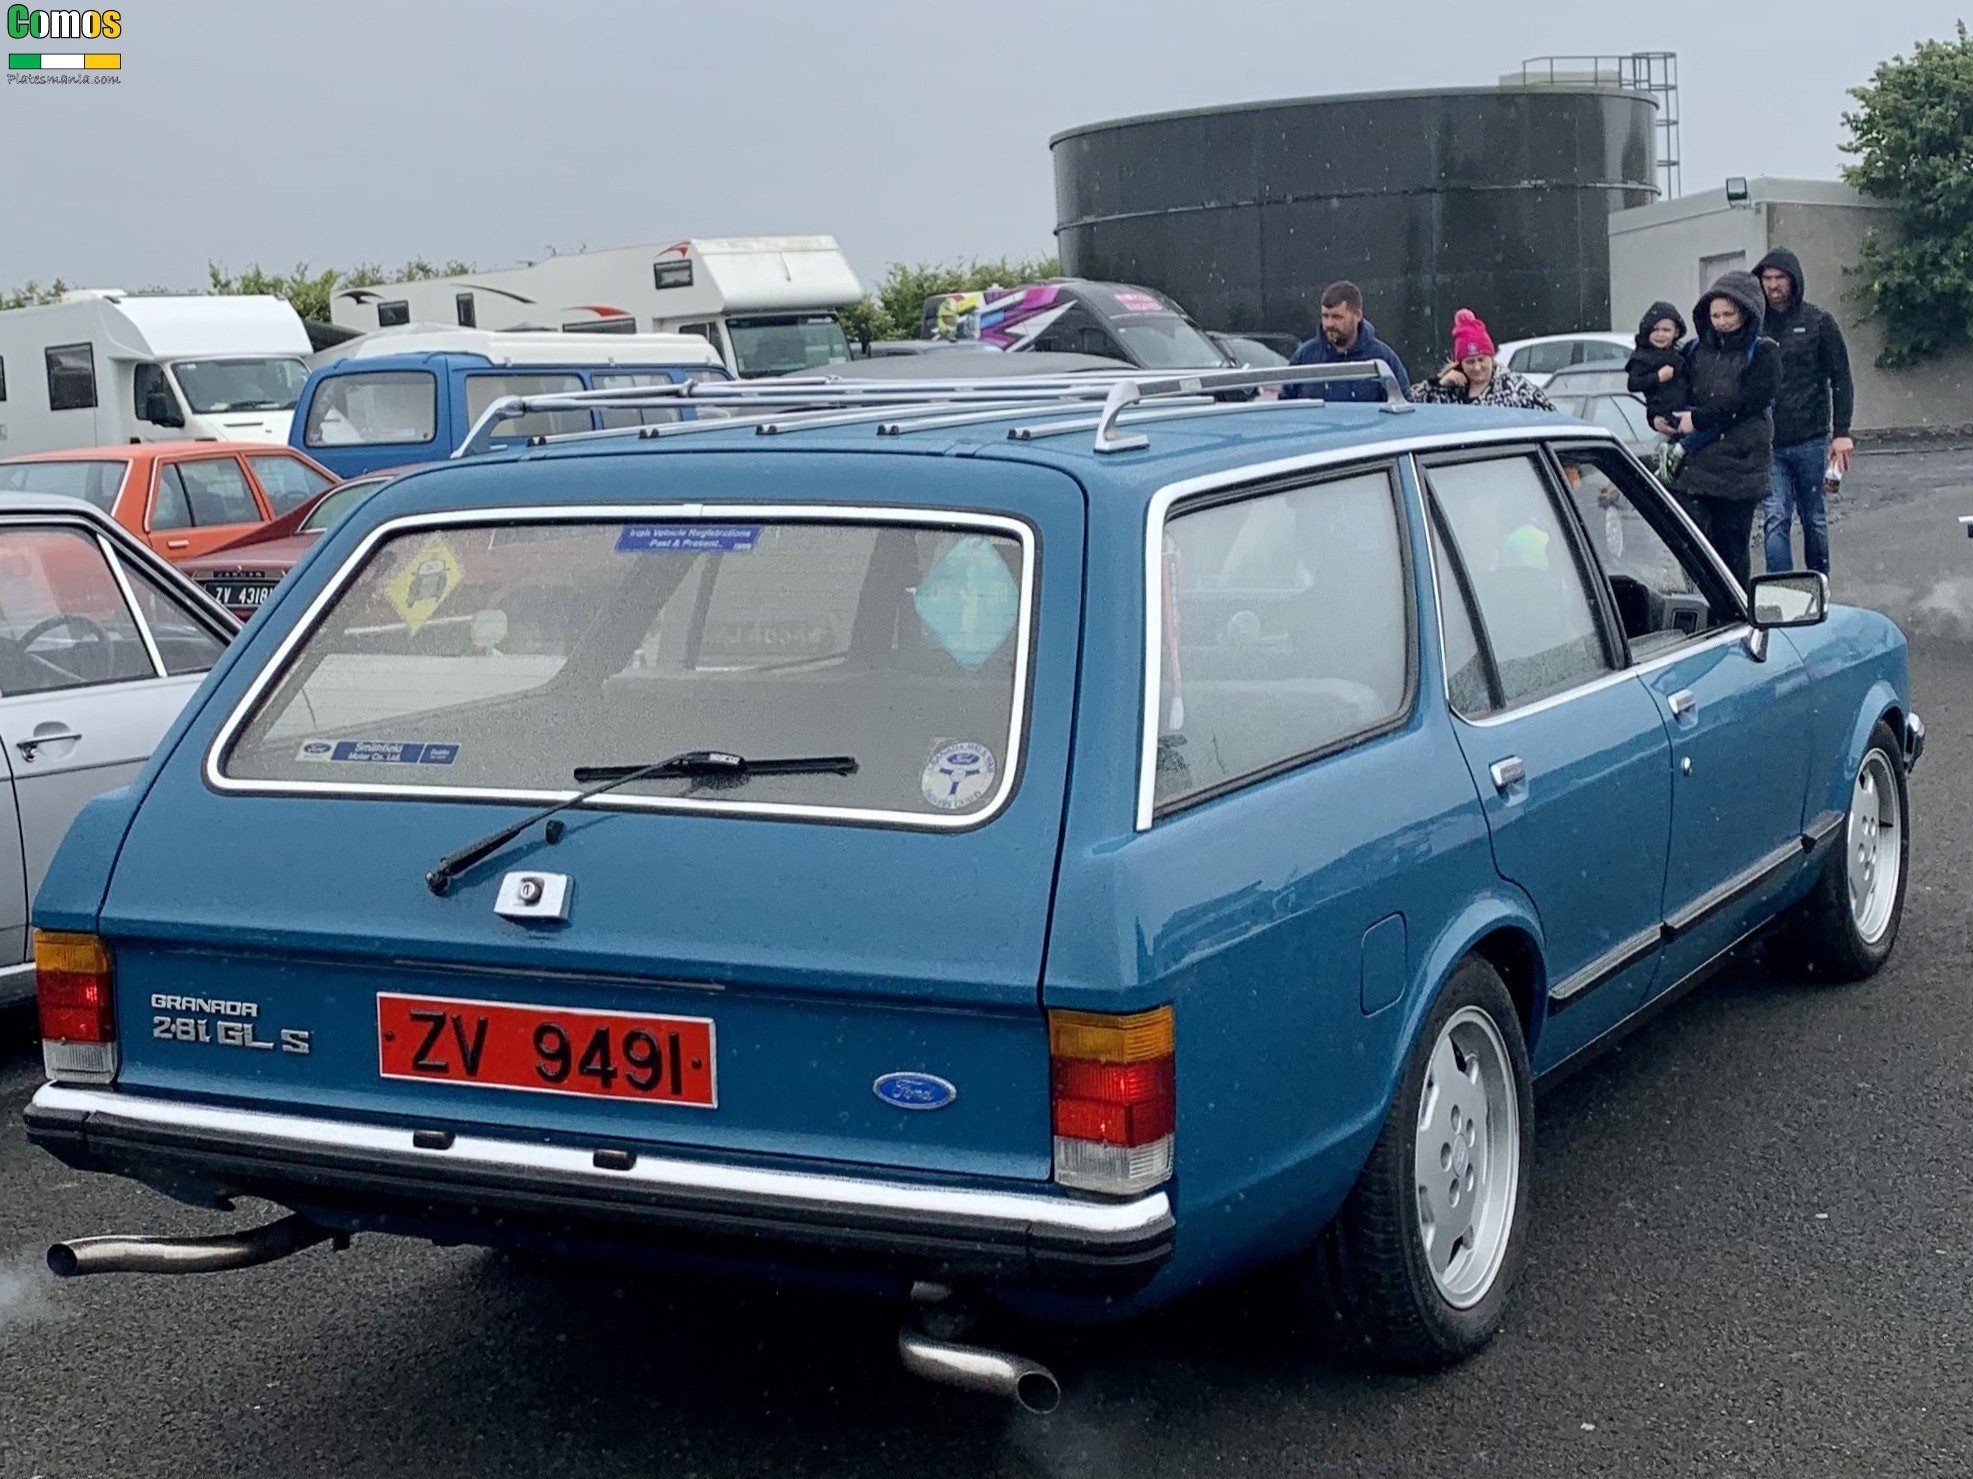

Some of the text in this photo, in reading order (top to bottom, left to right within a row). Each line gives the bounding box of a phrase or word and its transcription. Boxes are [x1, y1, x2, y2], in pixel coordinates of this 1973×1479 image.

[215, 587, 232, 604] ZV
[151, 993, 258, 1017] GRANADA
[217, 1020, 274, 1049] GL
[281, 1028, 310, 1054] S
[410, 1008, 683, 1096] ZV 9491
